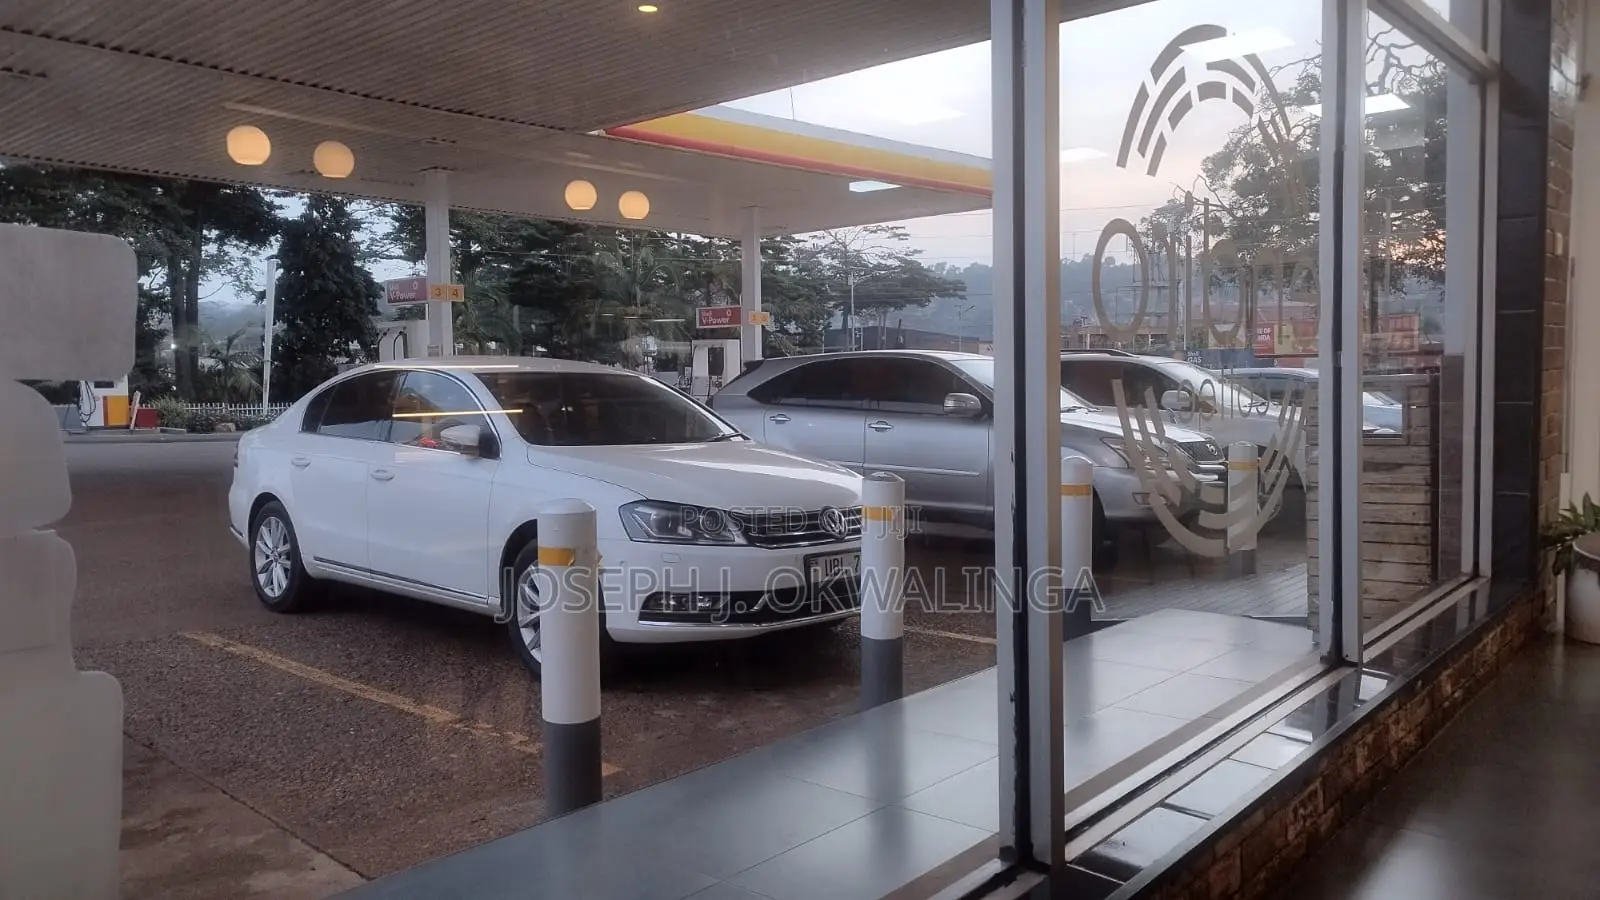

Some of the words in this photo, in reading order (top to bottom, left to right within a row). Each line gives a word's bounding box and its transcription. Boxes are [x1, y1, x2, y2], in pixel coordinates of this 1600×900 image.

[390, 290, 417, 300] V-Power
[434, 287, 442, 297] 3
[451, 287, 459, 297] 4
[702, 317, 730, 325] V-Power
